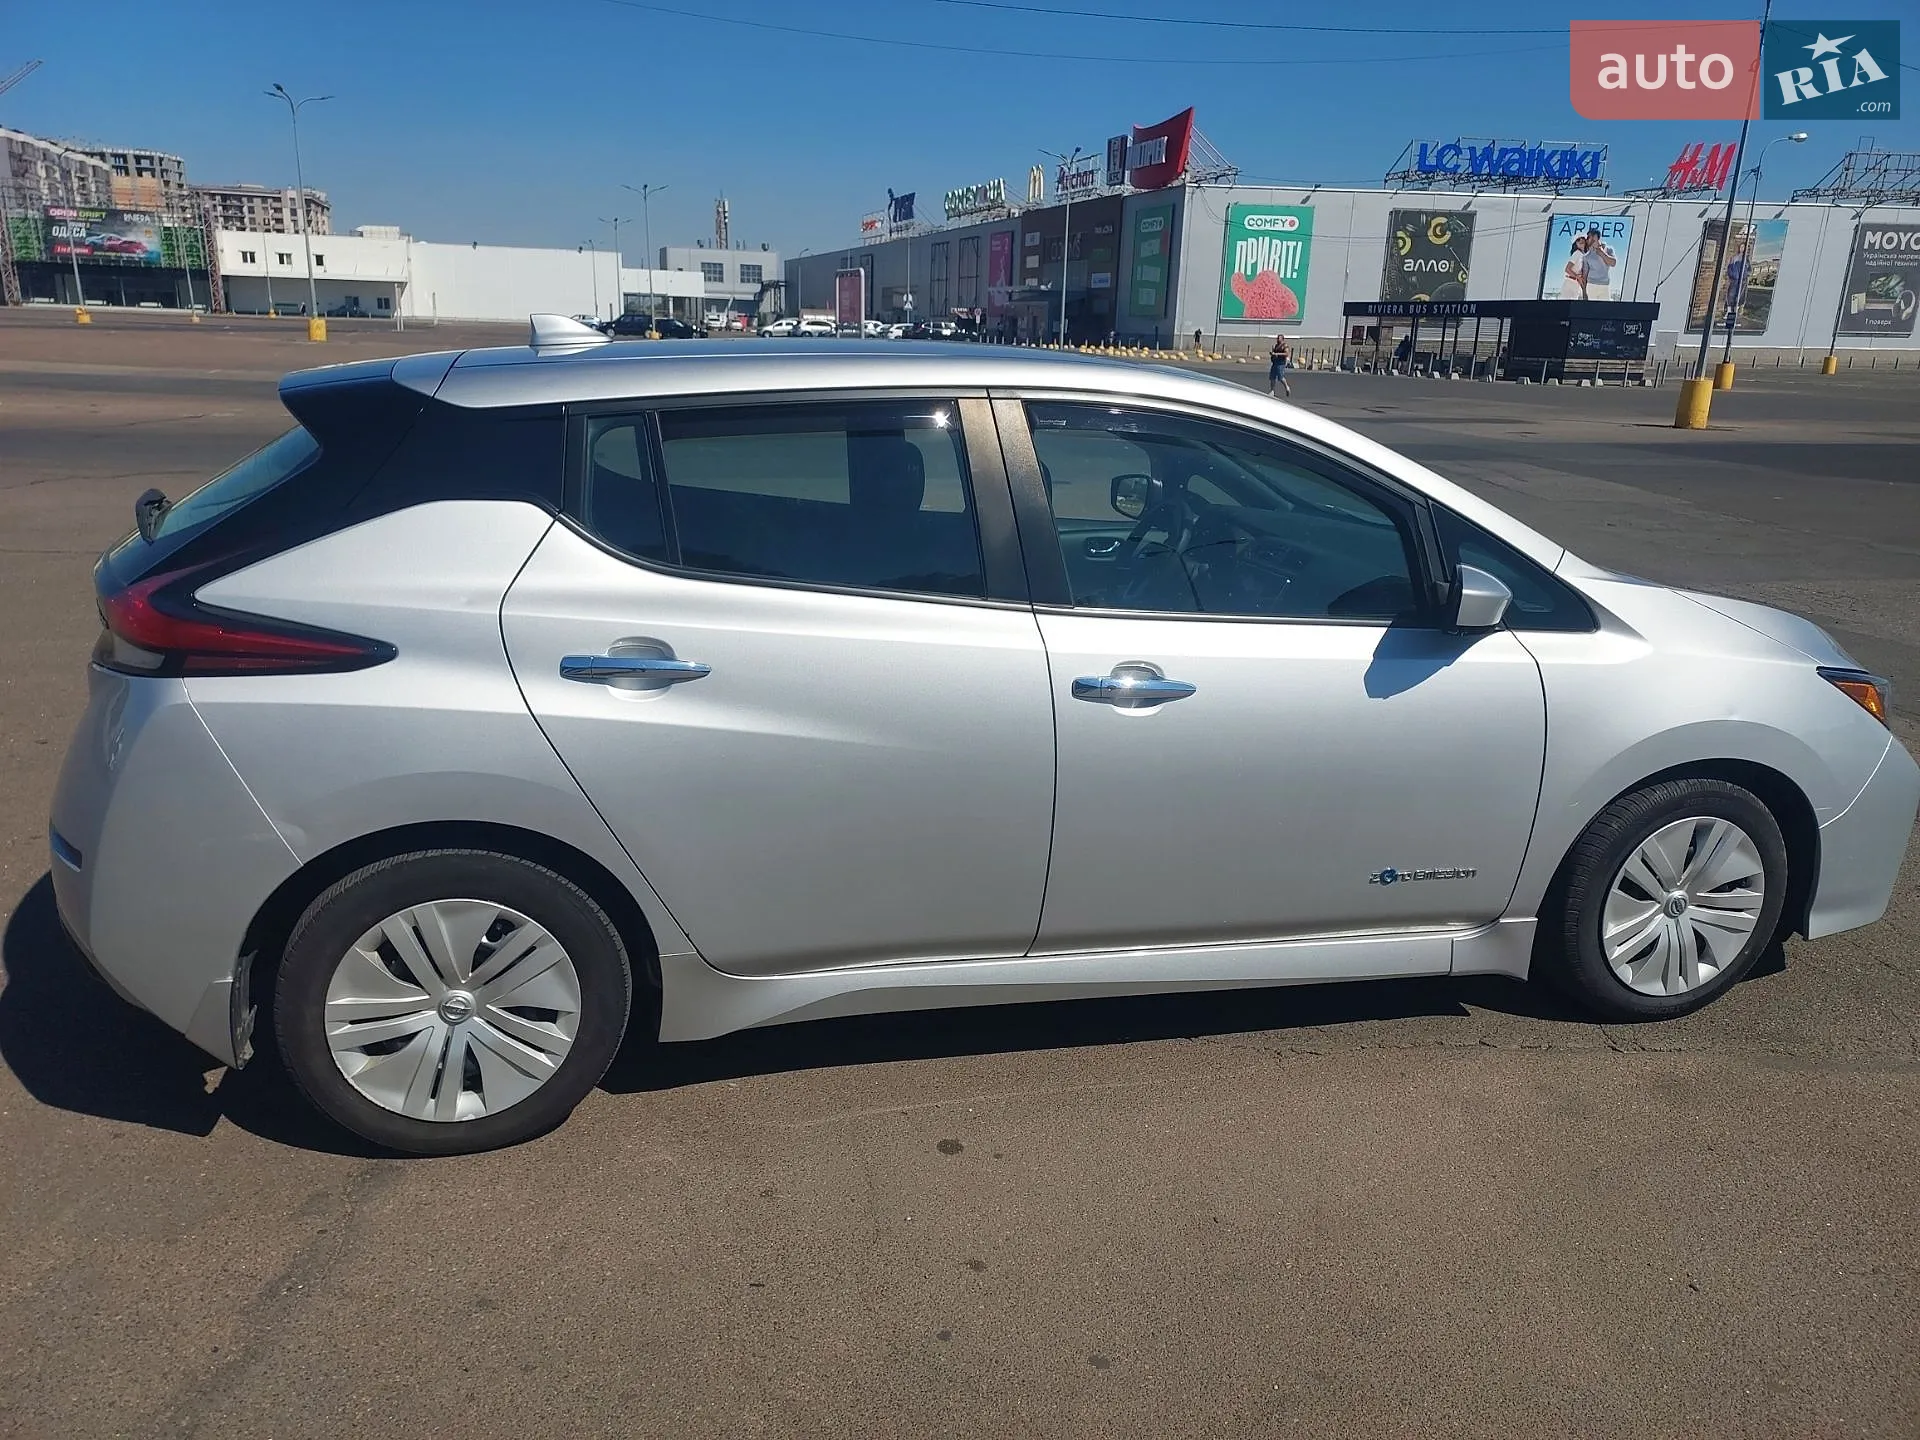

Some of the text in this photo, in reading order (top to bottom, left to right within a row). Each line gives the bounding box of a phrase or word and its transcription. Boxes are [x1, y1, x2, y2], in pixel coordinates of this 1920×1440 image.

[1417, 143, 1463, 173] LC
[1668, 143, 1737, 191] H&M
[1247, 217, 1288, 228] COMFY
[1234, 236, 1302, 278] ПРИВІТ!
[1367, 304, 1477, 314] RIVIERA BUS STATION
